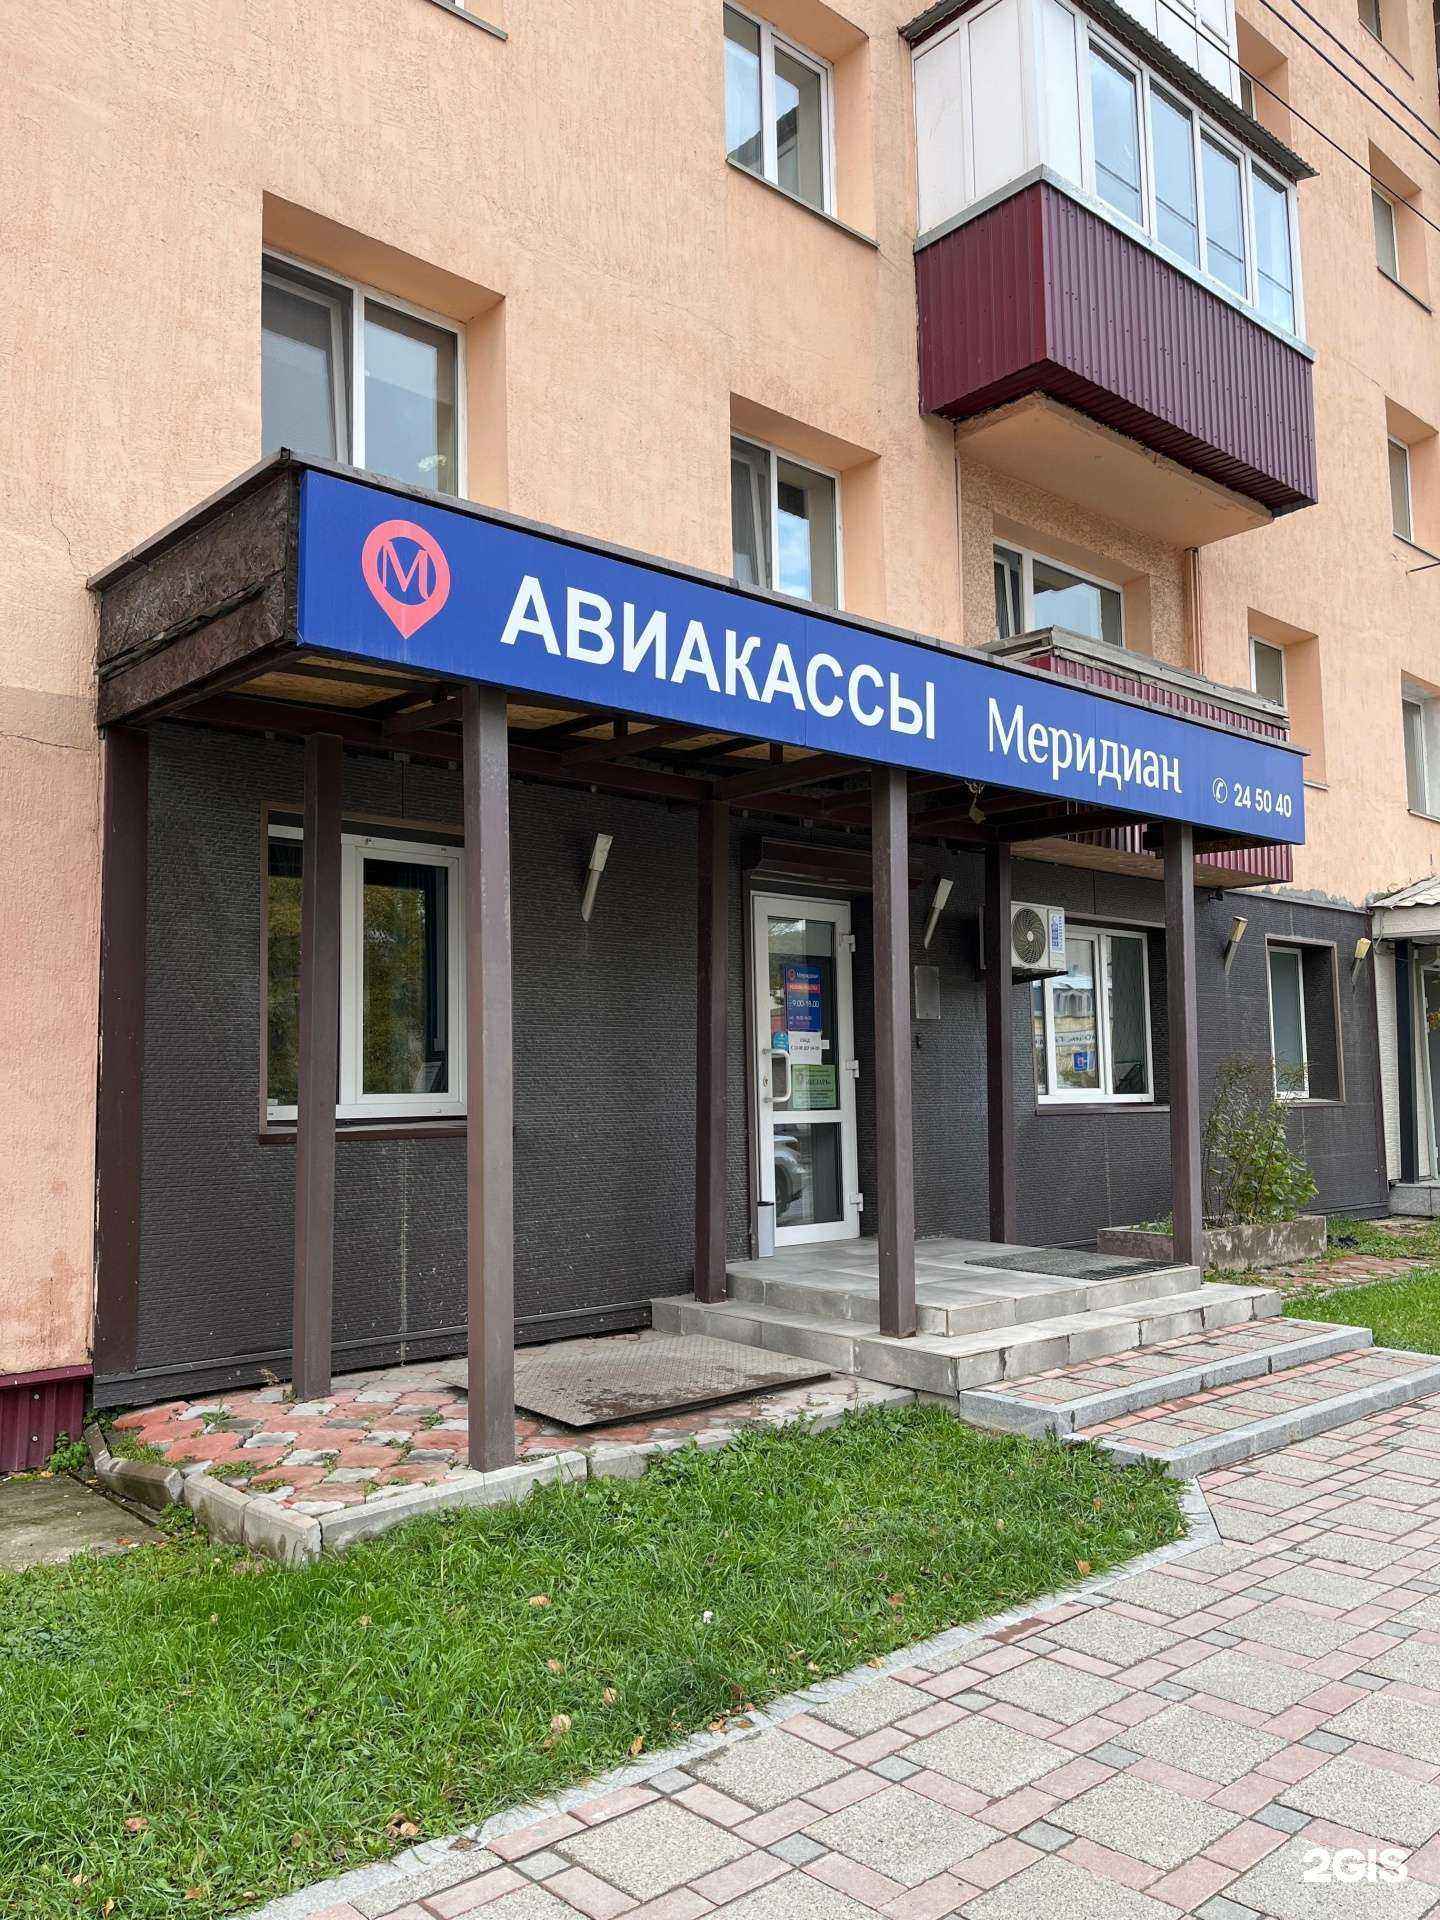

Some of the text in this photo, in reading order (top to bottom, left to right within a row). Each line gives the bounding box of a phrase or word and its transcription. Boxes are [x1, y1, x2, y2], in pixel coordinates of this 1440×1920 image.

[500, 575, 936, 740] АВИАКАССЫ
[987, 697, 1183, 794] Меридиан
[1234, 782, 1292, 818] 24 50 40
